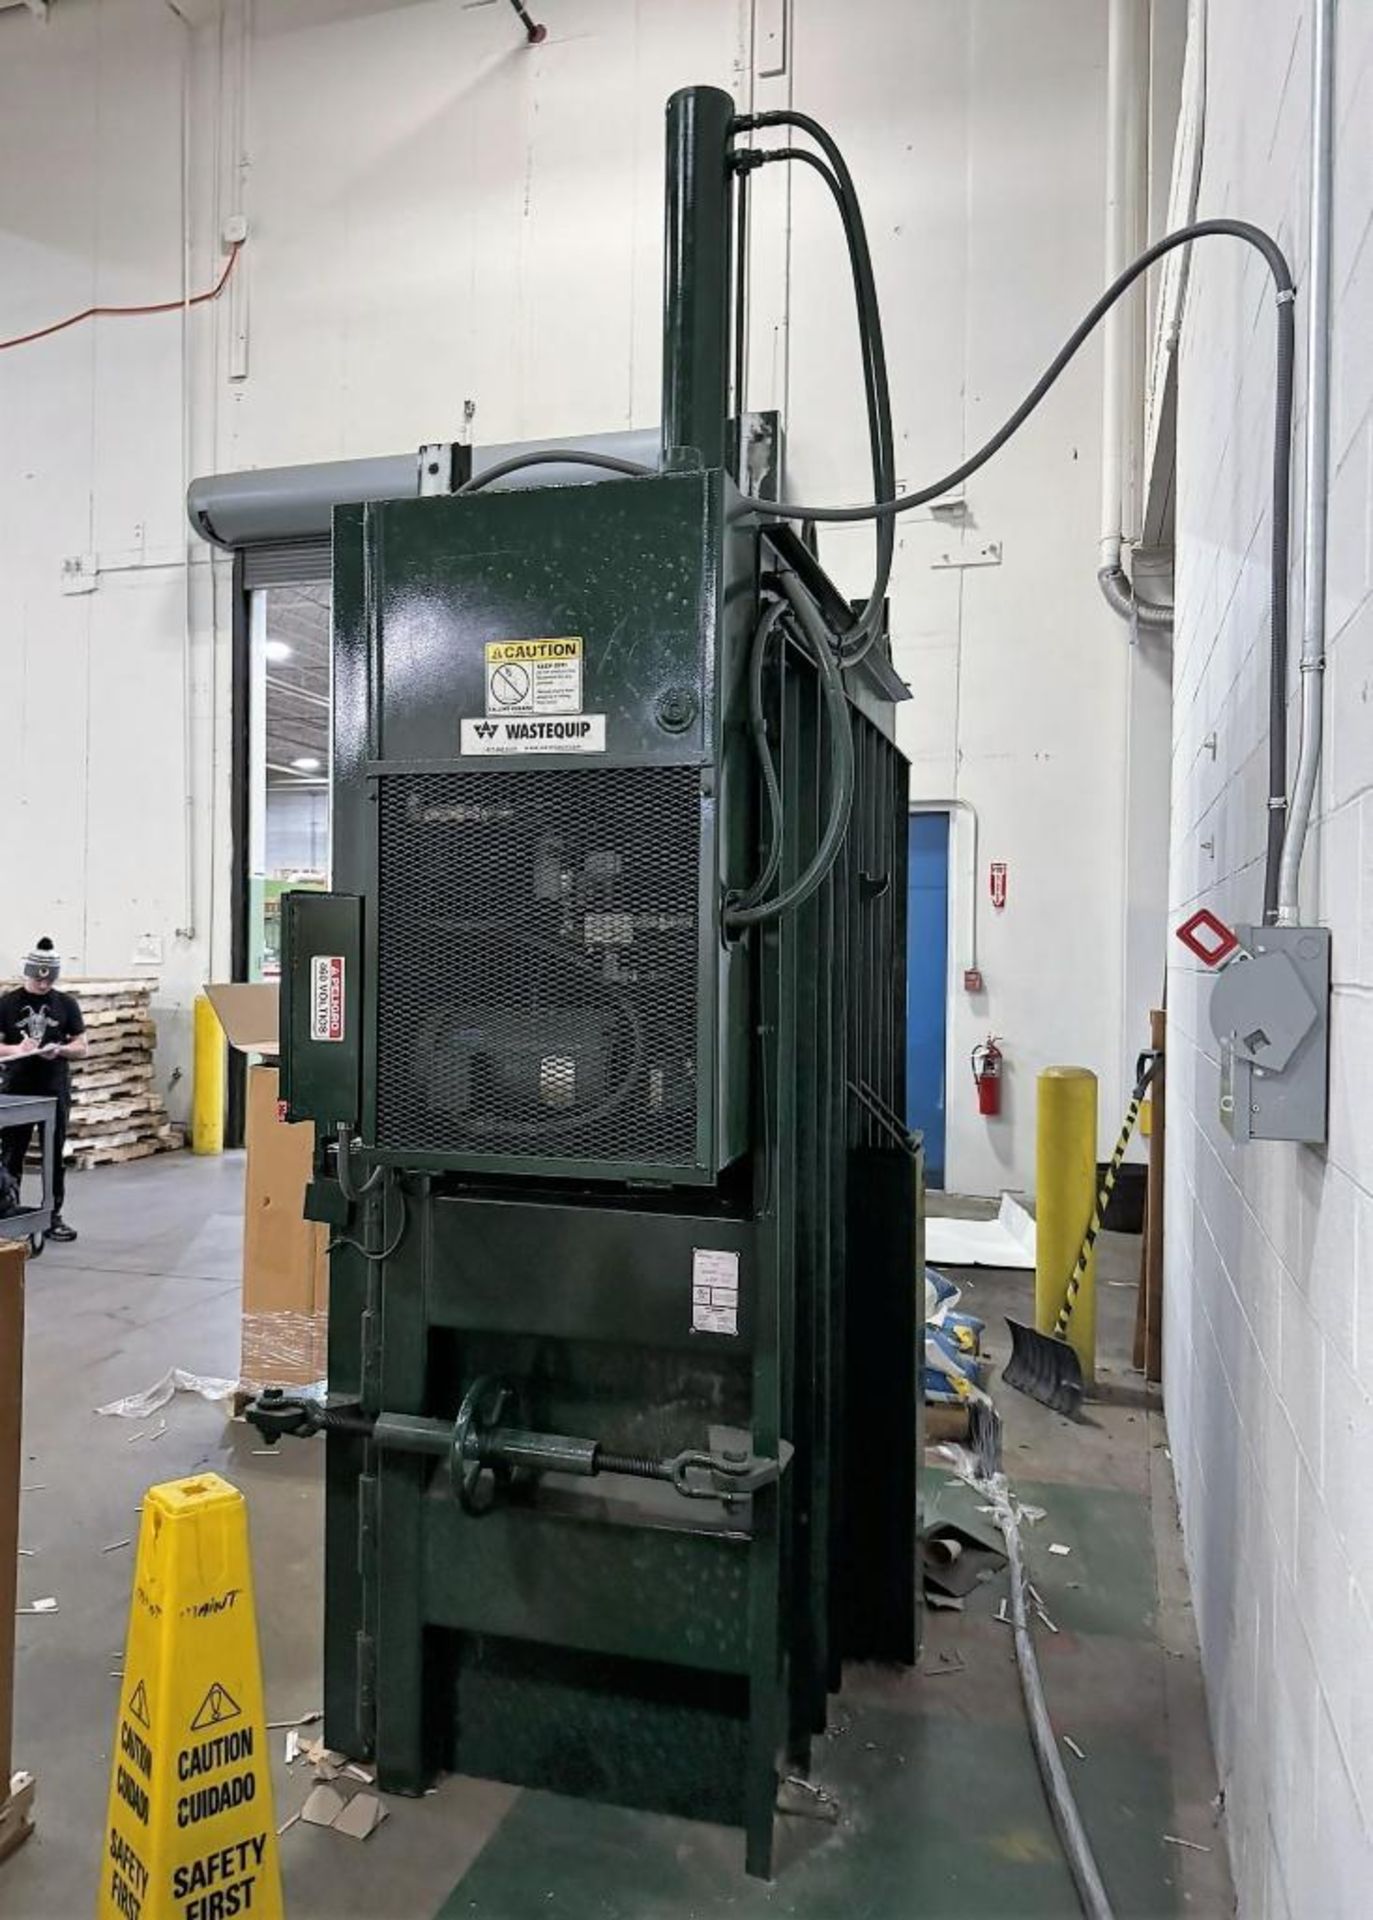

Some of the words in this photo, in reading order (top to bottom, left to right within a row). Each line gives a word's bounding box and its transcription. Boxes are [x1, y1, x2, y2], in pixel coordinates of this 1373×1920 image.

[504, 643, 576, 658] CAUTION
[505, 722, 591, 740] WASTEQUIP
[121, 1721, 153, 1781] CAUTION
[178, 1727, 253, 1781] CAUTION
[117, 1765, 149, 1826] CUIDADO
[177, 1772, 256, 1828] CUIDADO
[110, 1828, 149, 1899] SAFETY
[173, 1833, 267, 1899] SAFETY
[111, 1870, 142, 1920] FIRST
[185, 1877, 256, 1920] FIRST
